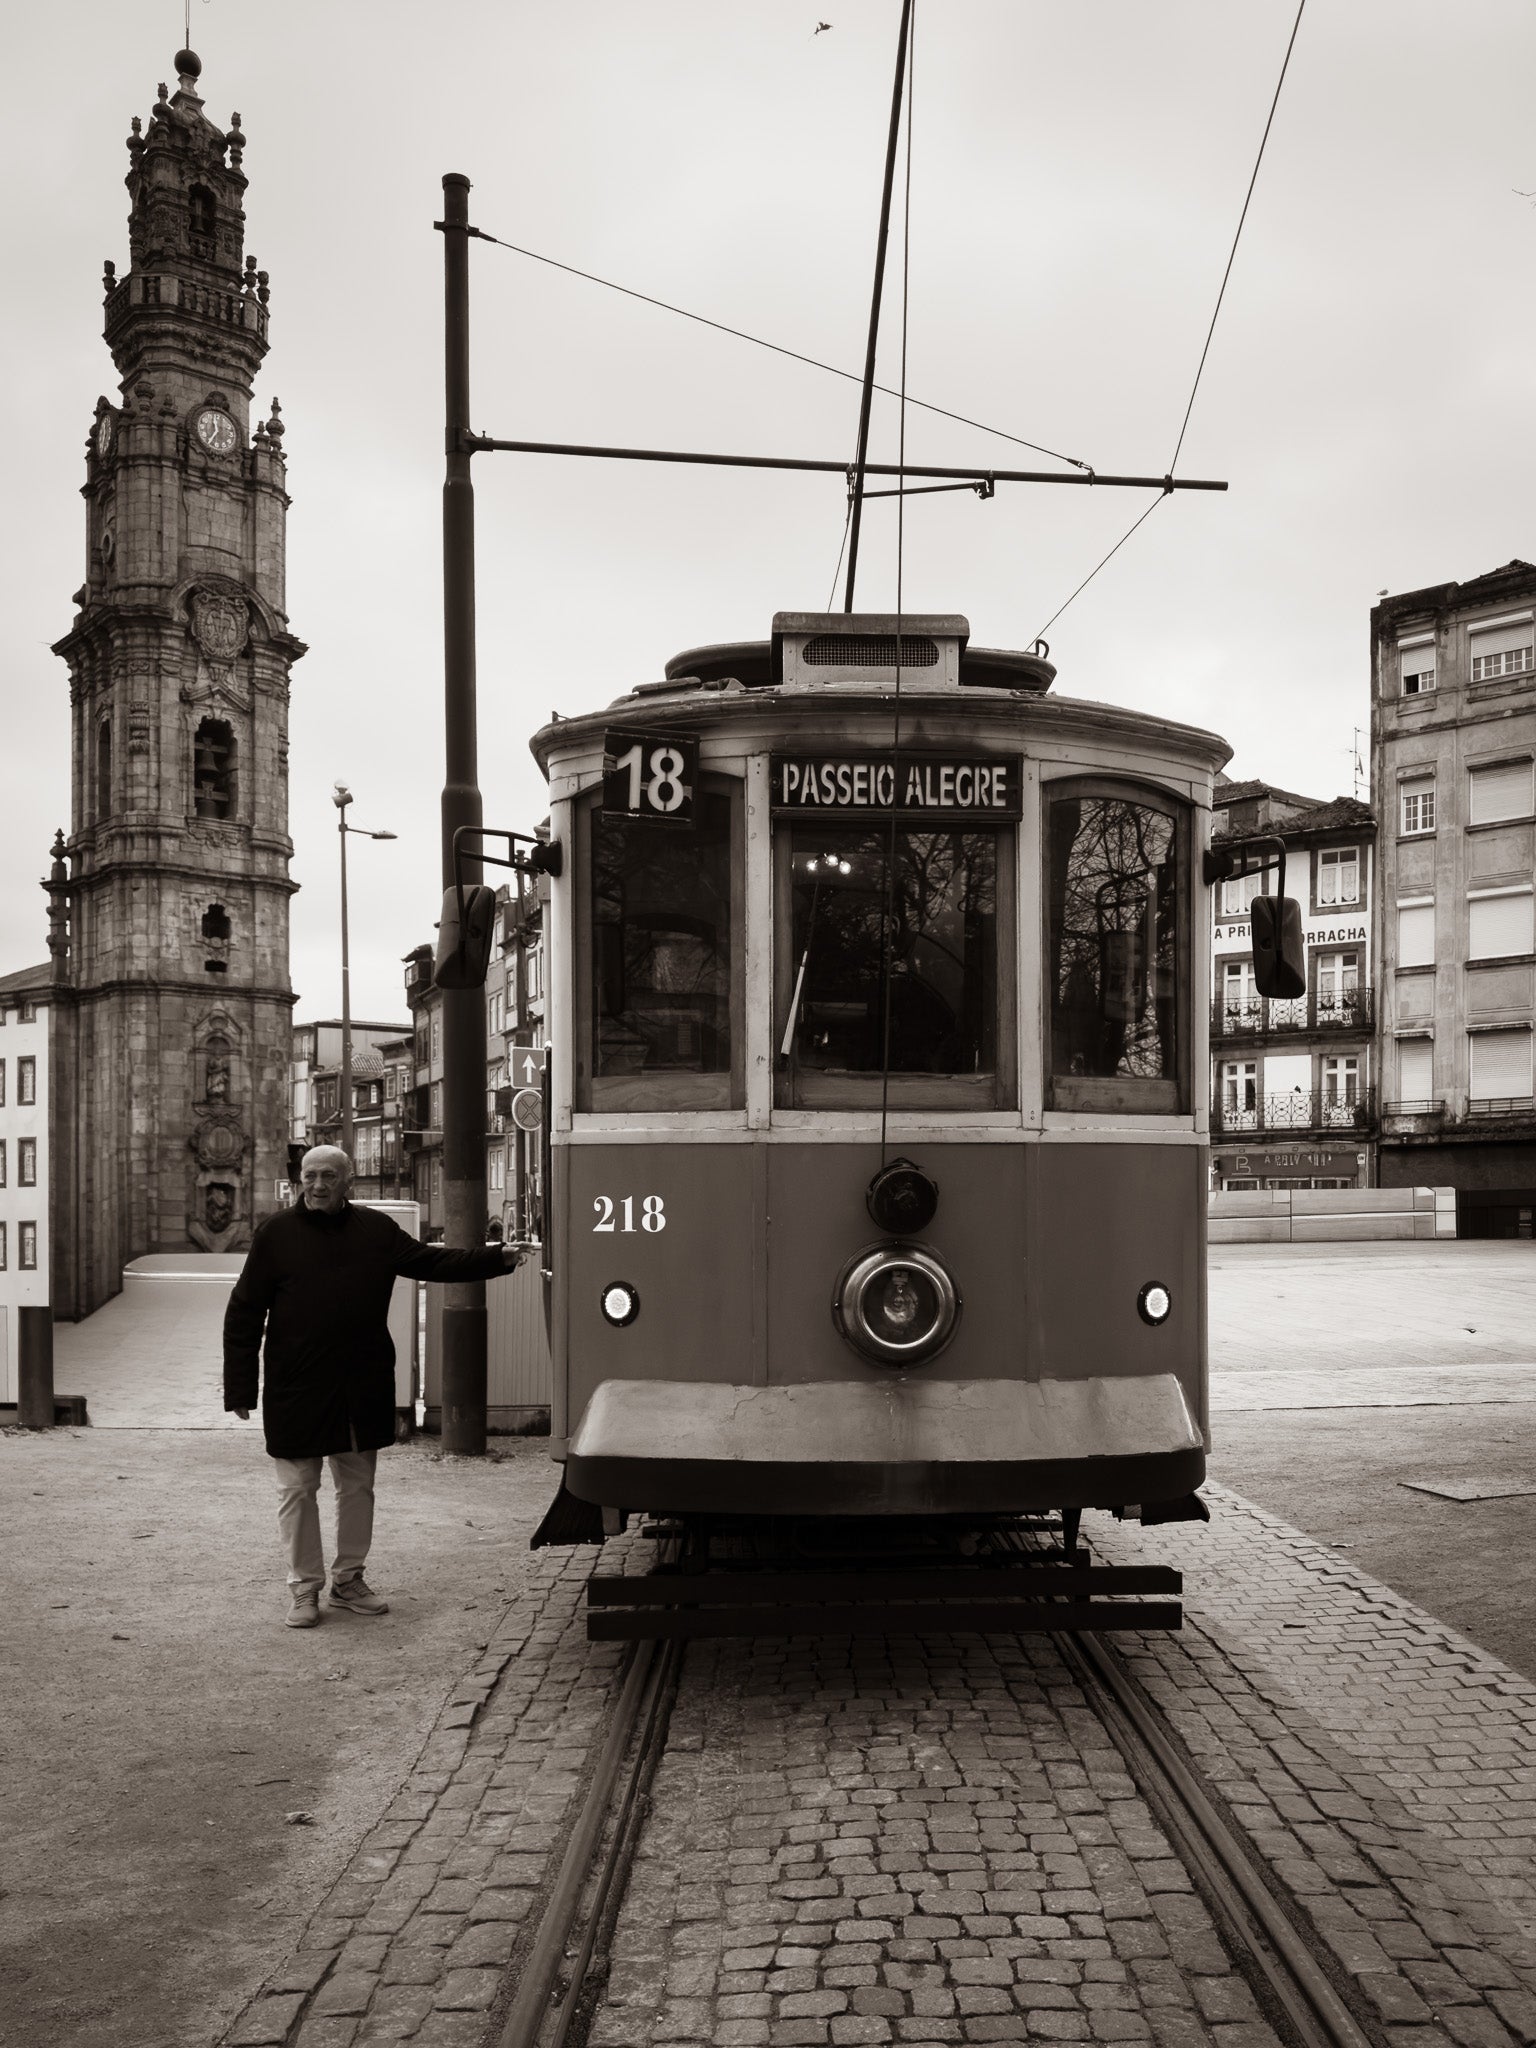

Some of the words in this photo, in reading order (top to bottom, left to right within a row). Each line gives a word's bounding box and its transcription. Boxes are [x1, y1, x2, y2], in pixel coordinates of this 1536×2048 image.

[616, 745, 684, 812] 18
[782, 763, 895, 806] PASSEIO
[905, 765, 1007, 807] ALEGRE
[1214, 928, 1222, 939] A
[1228, 925, 1251, 938] PRI
[592, 1195, 666, 1233] 218
